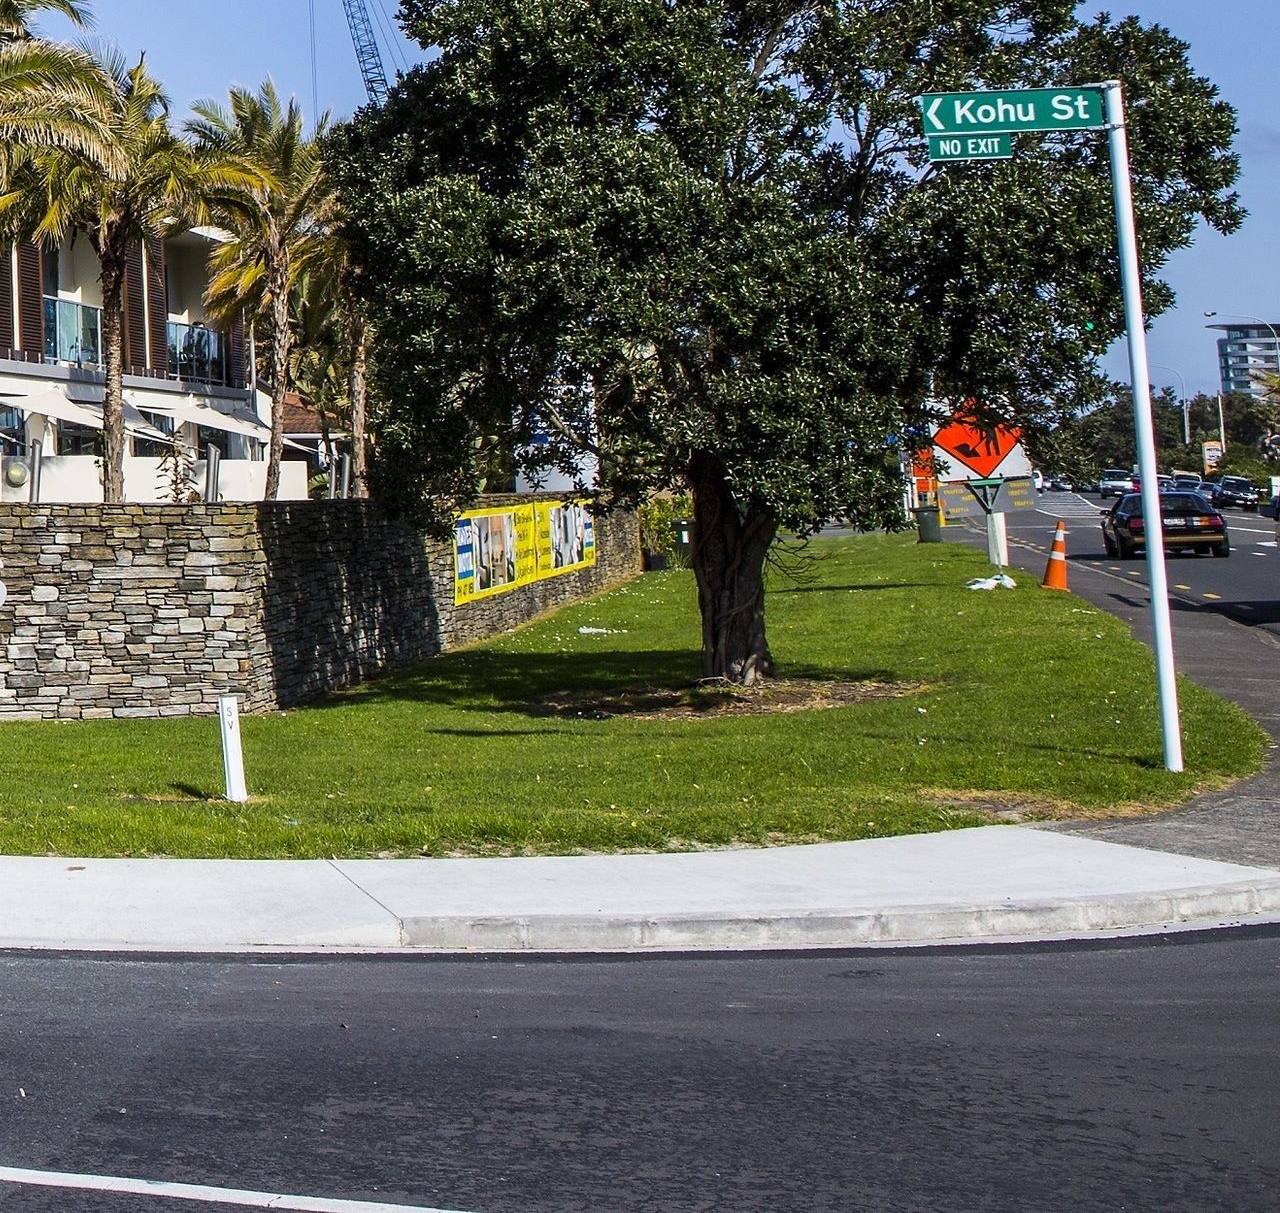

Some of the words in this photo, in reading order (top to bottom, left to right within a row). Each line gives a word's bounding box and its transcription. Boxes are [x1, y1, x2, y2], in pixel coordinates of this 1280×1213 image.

[954, 98, 1036, 124] Kohu
[1051, 94, 1090, 120] St
[940, 139, 961, 155] NO
[967, 138, 1001, 154] EXIT
